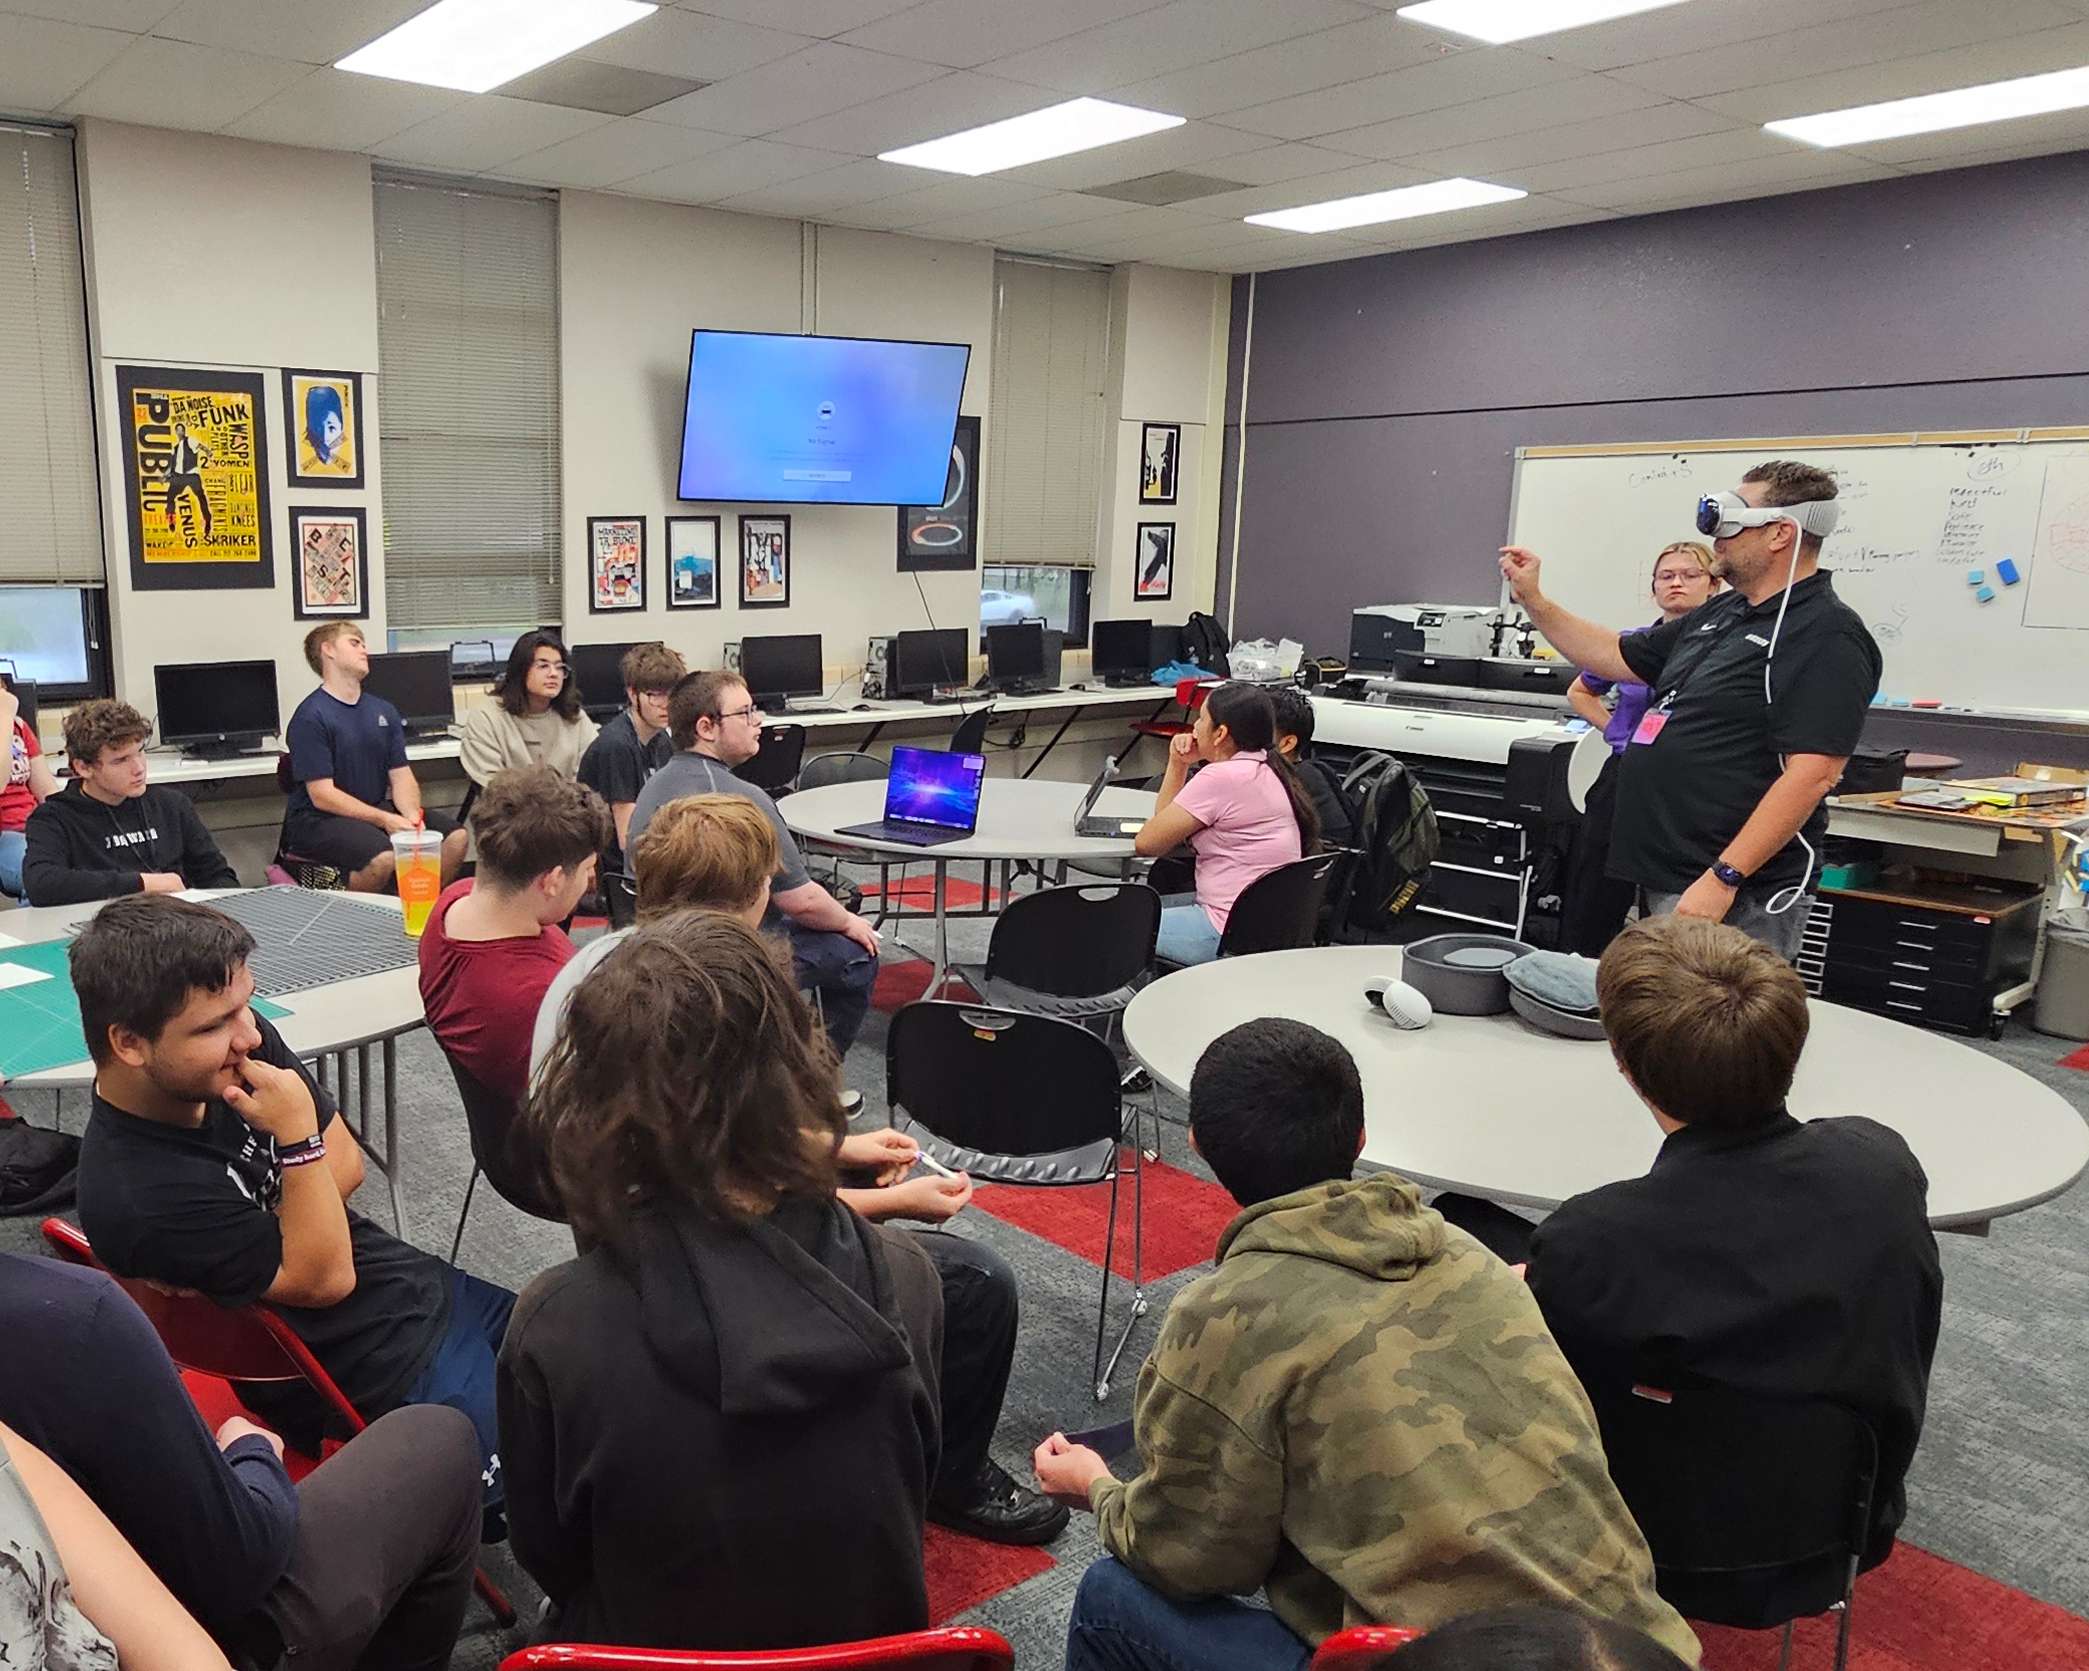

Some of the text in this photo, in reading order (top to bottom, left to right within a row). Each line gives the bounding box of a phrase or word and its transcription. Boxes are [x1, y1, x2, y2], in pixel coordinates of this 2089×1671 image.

[187, 396, 215, 411] NOISE
[198, 404, 249, 427] FUNK
[229, 424, 249, 459] WASP
[136, 393, 172, 512] PUBLIC
[200, 456, 209, 469] 2
[177, 494, 198, 548] VENUS
[231, 515, 255, 527] KNEES
[204, 534, 256, 547] SKRIKER
